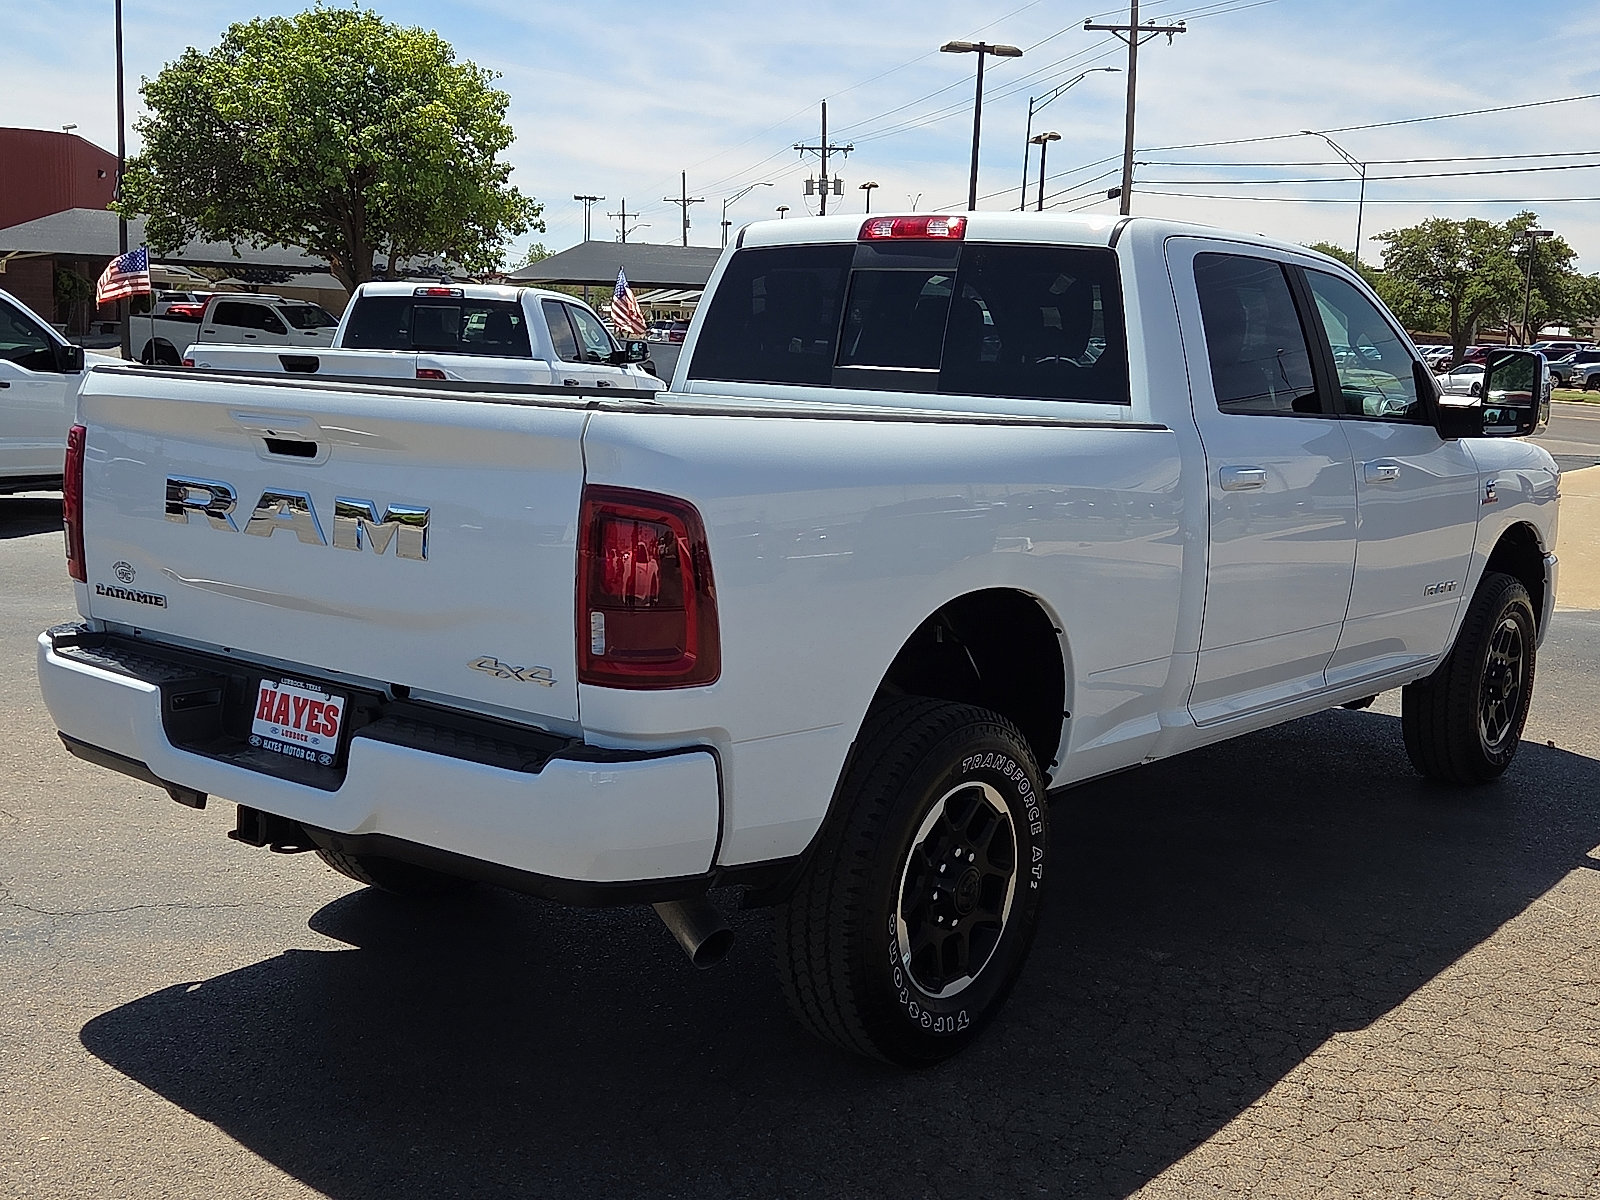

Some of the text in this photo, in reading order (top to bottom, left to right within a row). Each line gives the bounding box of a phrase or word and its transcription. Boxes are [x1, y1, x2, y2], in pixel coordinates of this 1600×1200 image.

[164, 474, 430, 560] RAM
[95, 582, 168, 609] LARAMIE
[305, 682, 322, 692] TEXAS
[256, 688, 340, 738] HAYES
[262, 739, 282, 753] HAYES
[282, 744, 305, 759] MOTOR
[305, 750, 317, 762] CO.
[281, 729, 308, 742] LUBBOCK
[962, 752, 1043, 836] TRANSFORCE
[888, 912, 970, 1033] Firestone
